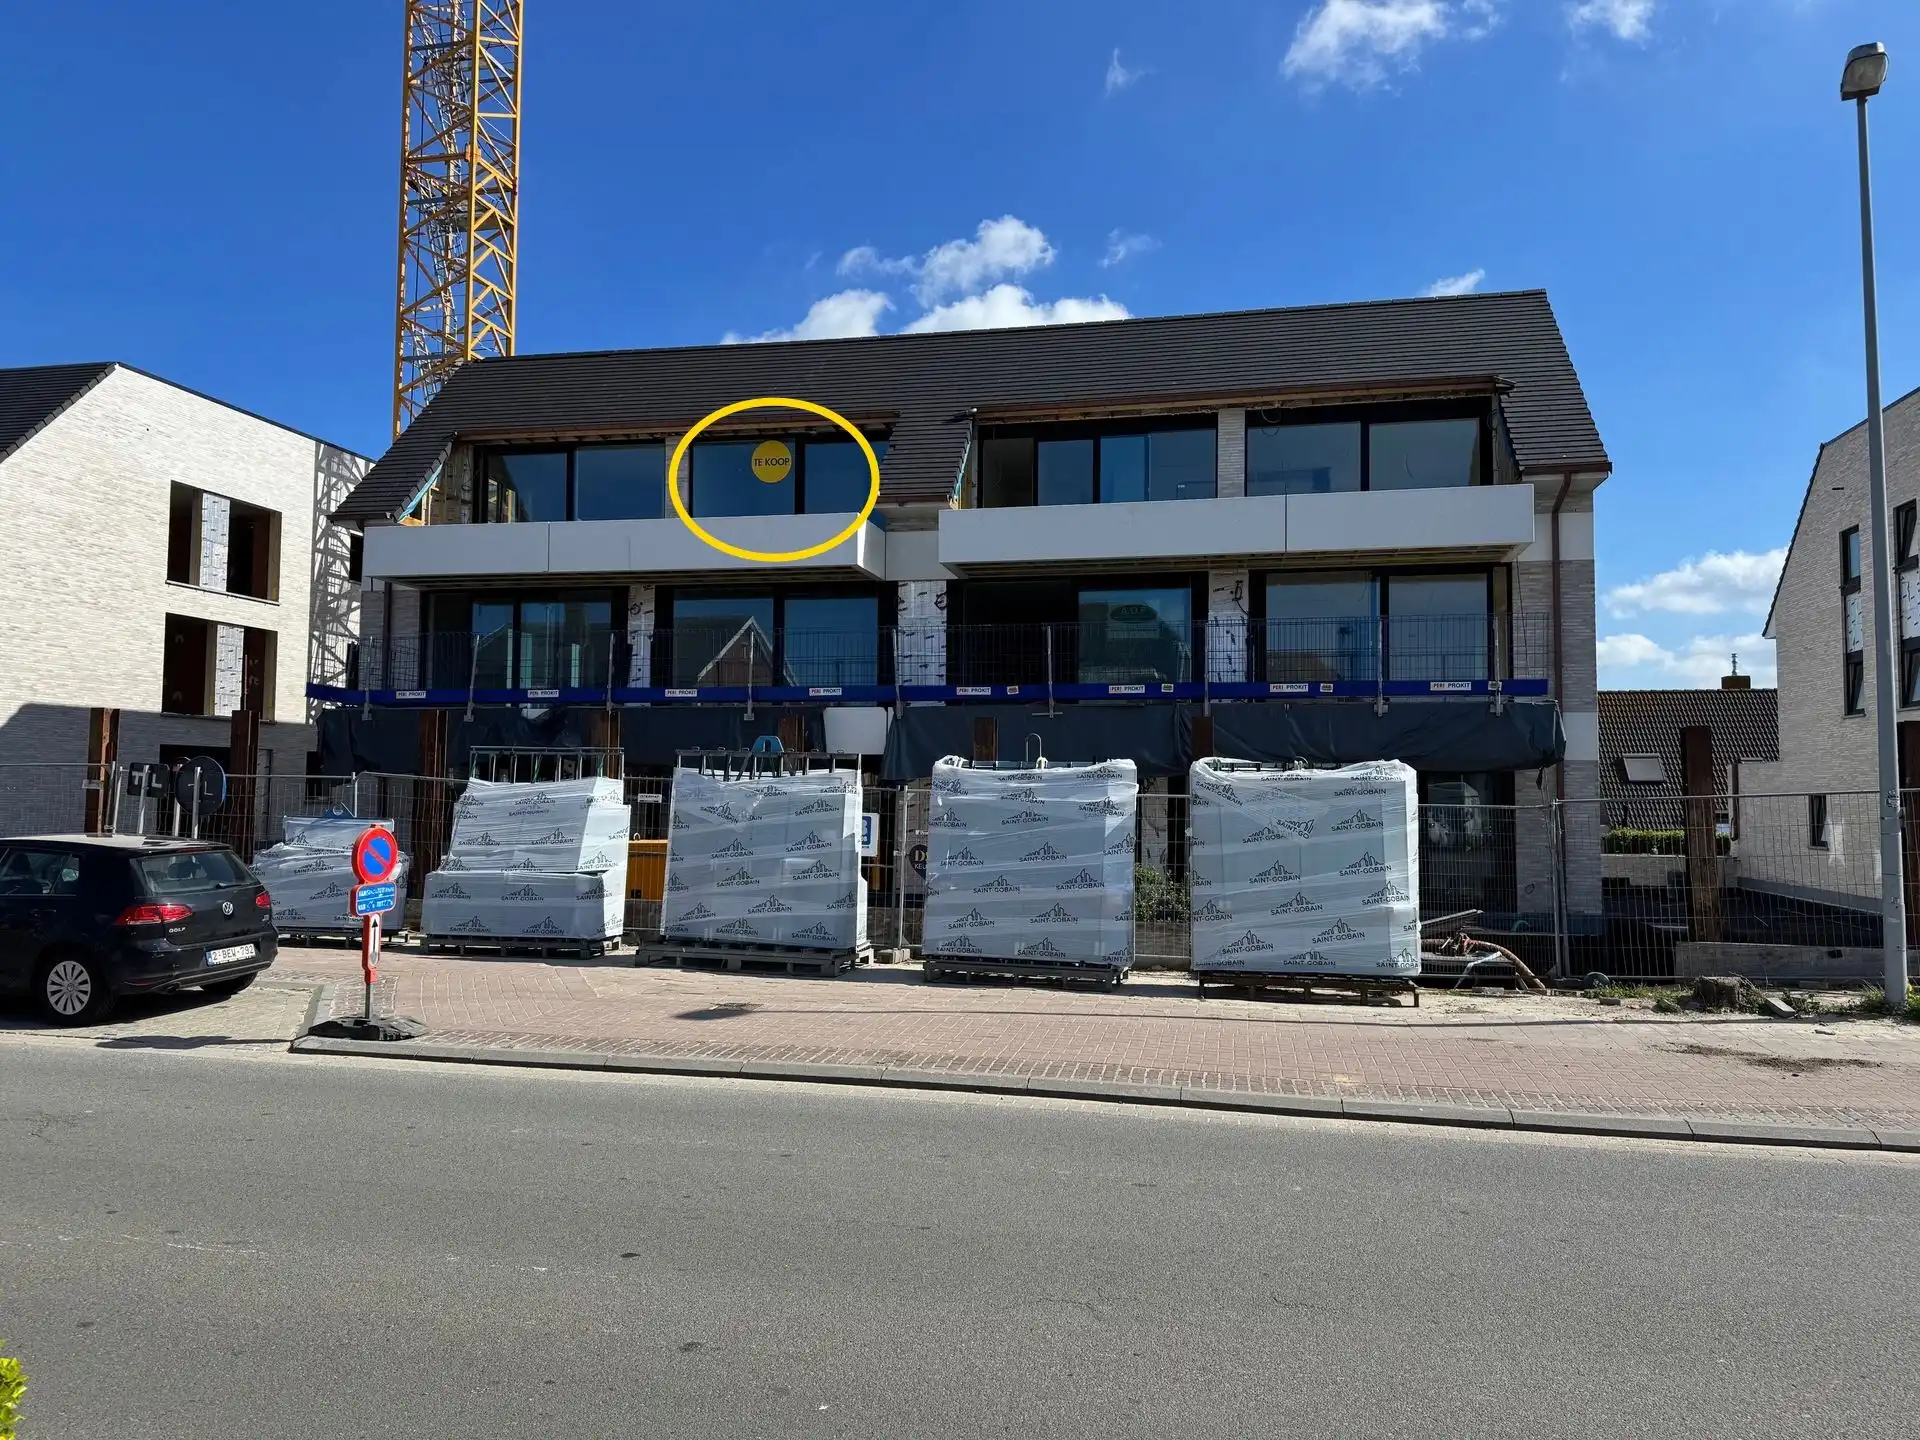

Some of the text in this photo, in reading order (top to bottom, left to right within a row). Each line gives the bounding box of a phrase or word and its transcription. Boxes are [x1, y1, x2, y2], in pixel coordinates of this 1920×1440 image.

[754, 457, 790, 467] TE KOOP
[1002, 817, 1048, 825] SAINT-GOBAIN
[1332, 821, 1384, 832] SAINT-GOBAIN
[786, 843, 832, 852] SAINT-GOBAIN
[711, 851, 753, 859] SAINT-GOBAIN
[1340, 865, 1391, 877] SAINT-GOBAIN
[793, 872, 839, 880] SAINT-GOBAIN
[1249, 875, 1301, 884] SAINT-GOBAIN
[973, 886, 1020, 894] SAINT-GOBAIN
[748, 906, 792, 914] SAINT-GOBAIN
[1271, 905, 1323, 916] SAINT-GOBAIN
[948, 921, 994, 929] SAINT-GOBAIN
[1312, 932, 1365, 944] SAINT-GOBAIN
[1222, 944, 1274, 954] SAINT-GOBAIN
[1017, 950, 1066, 958] SAINT-GOBAIN
